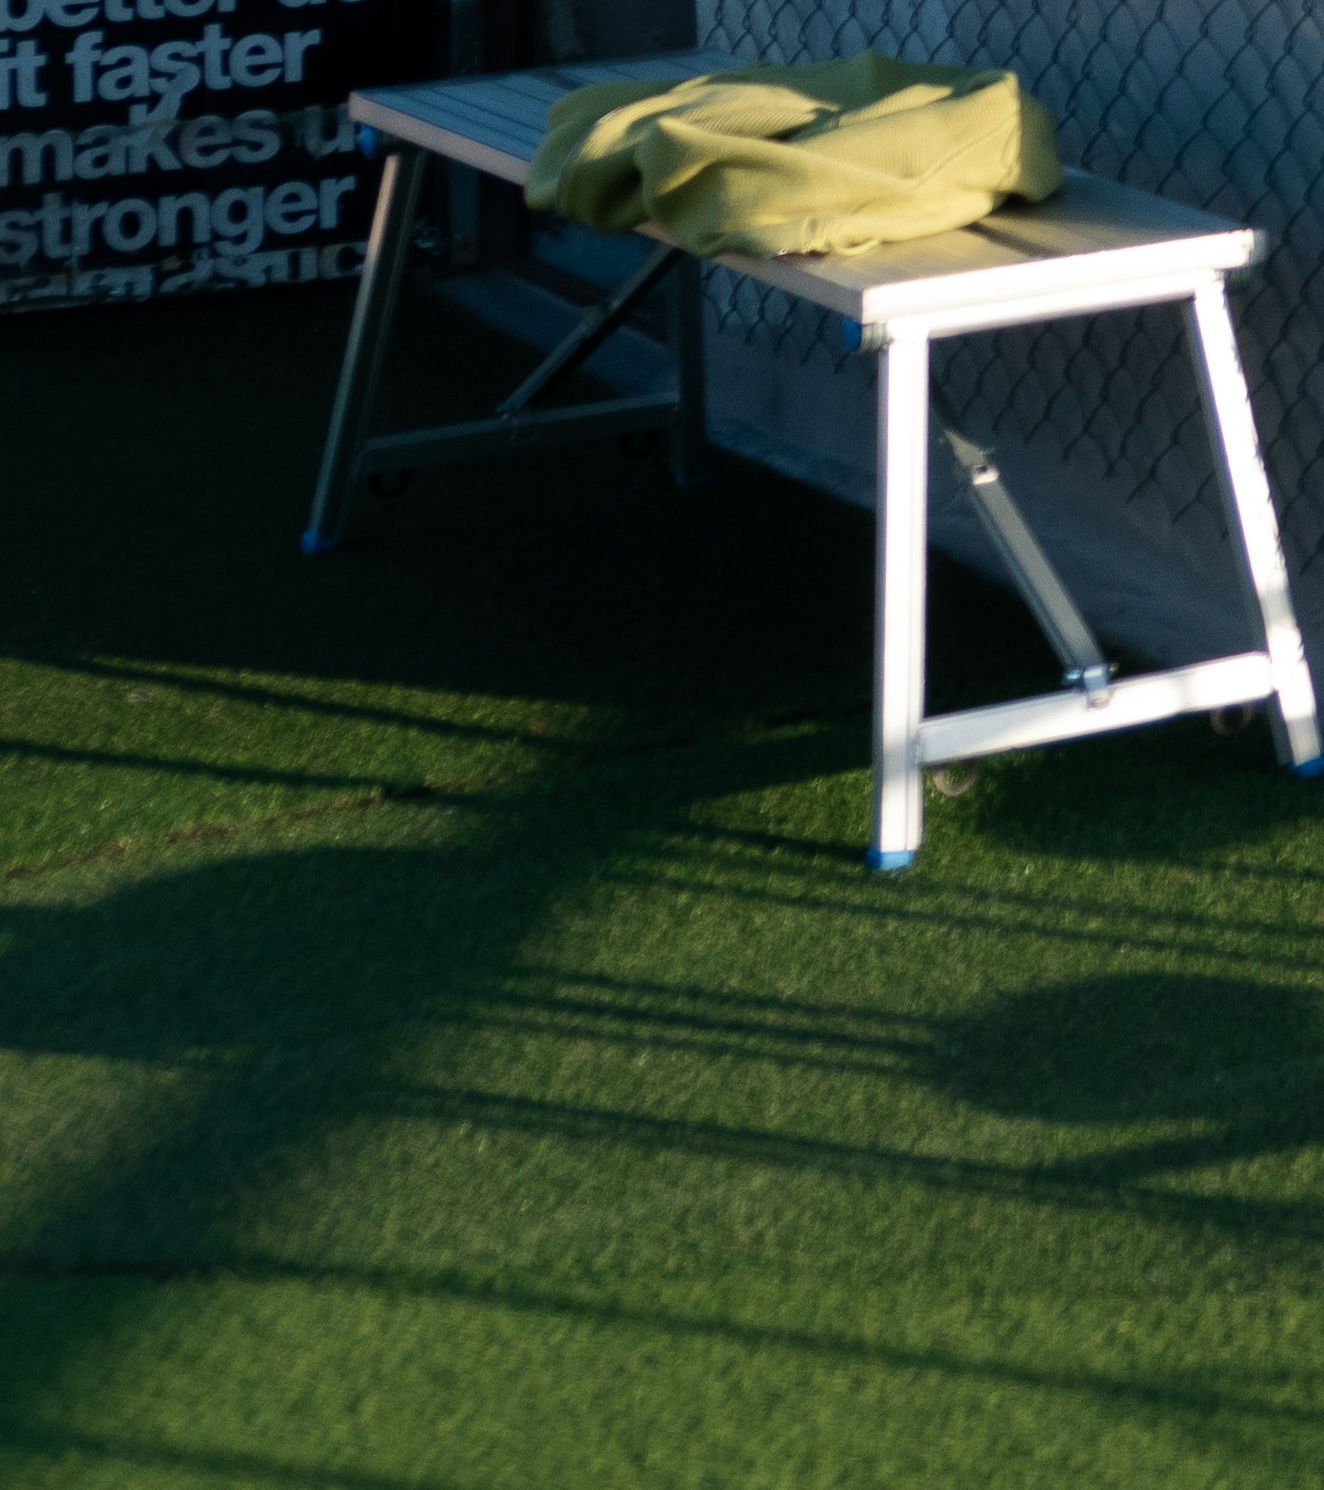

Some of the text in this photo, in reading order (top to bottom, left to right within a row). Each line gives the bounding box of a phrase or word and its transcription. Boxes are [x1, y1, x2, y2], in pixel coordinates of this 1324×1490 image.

[66, 25, 321, 103] faster
[0, 100, 355, 185] makes u
[0, 175, 356, 264] stronger
